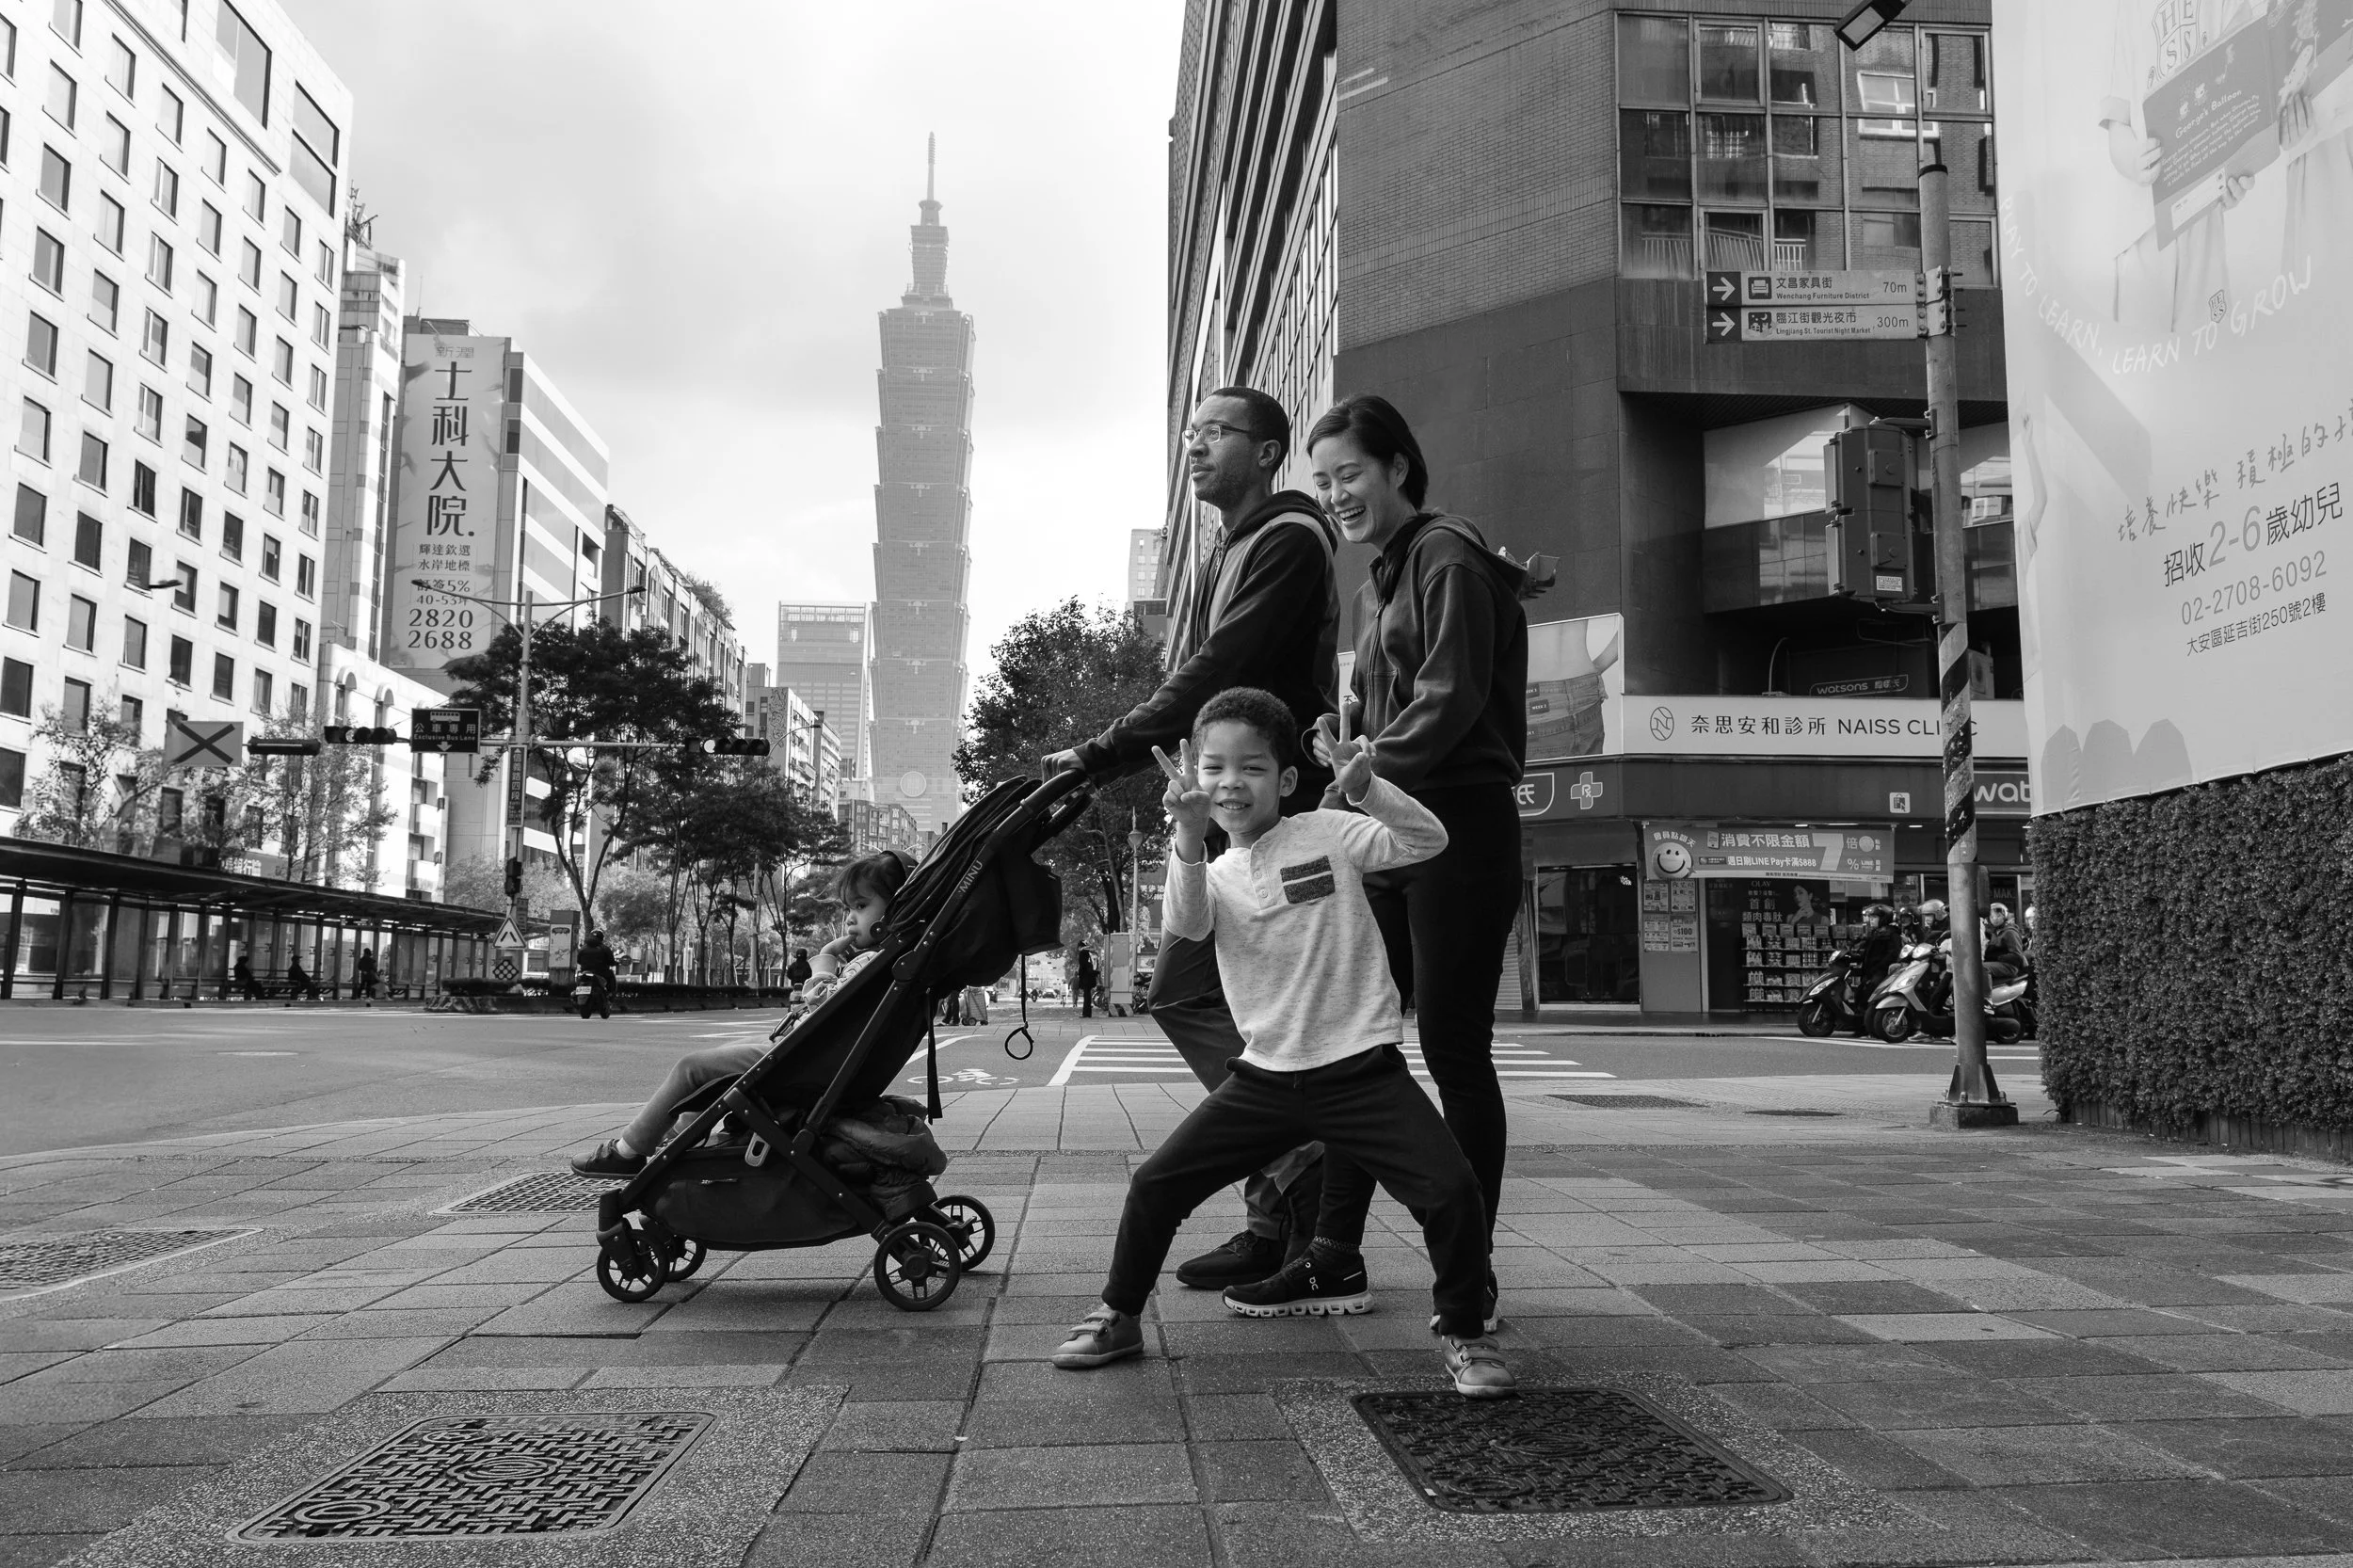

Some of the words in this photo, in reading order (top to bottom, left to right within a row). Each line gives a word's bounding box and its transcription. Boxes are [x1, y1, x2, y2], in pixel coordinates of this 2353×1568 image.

[2211, 89, 2242, 110] Balloon
[1776, 277, 1833, 289] 文昌家具街
[1883, 281, 1907, 294] 70m
[1999, 196, 2024, 258] PLAY
[2020, 262, 2038, 296] TO
[2112, 336, 2180, 376] LEARN
[2192, 321, 2217, 355] TO
[2231, 255, 2311, 337] GROW
[1776, 312, 1856, 324] 臨江街觀光夜市
[1877, 316, 1909, 328] 300m
[418, 558, 471, 572] 水岸地標
[2182, 551, 2327, 625] 02-2708-6092
[409, 608, 473, 628] 2820
[2186, 592, 2327, 657] 大安區延吉街250號2樓
[408, 630, 472, 649] 2688
[1817, 682, 1868, 695] watsons
[414, 723, 476, 734] 公車專用
[1690, 715, 1826, 735] 奈思安和診所
[1838, 718, 1901, 735] NAISS
[1721, 833, 1810, 848] 消費不限金額
[1812, 833, 1844, 872] 7
[1847, 837, 1858, 850] 倍
[959, 860, 983, 893] MINU
[1749, 898, 1776, 910] 首創
